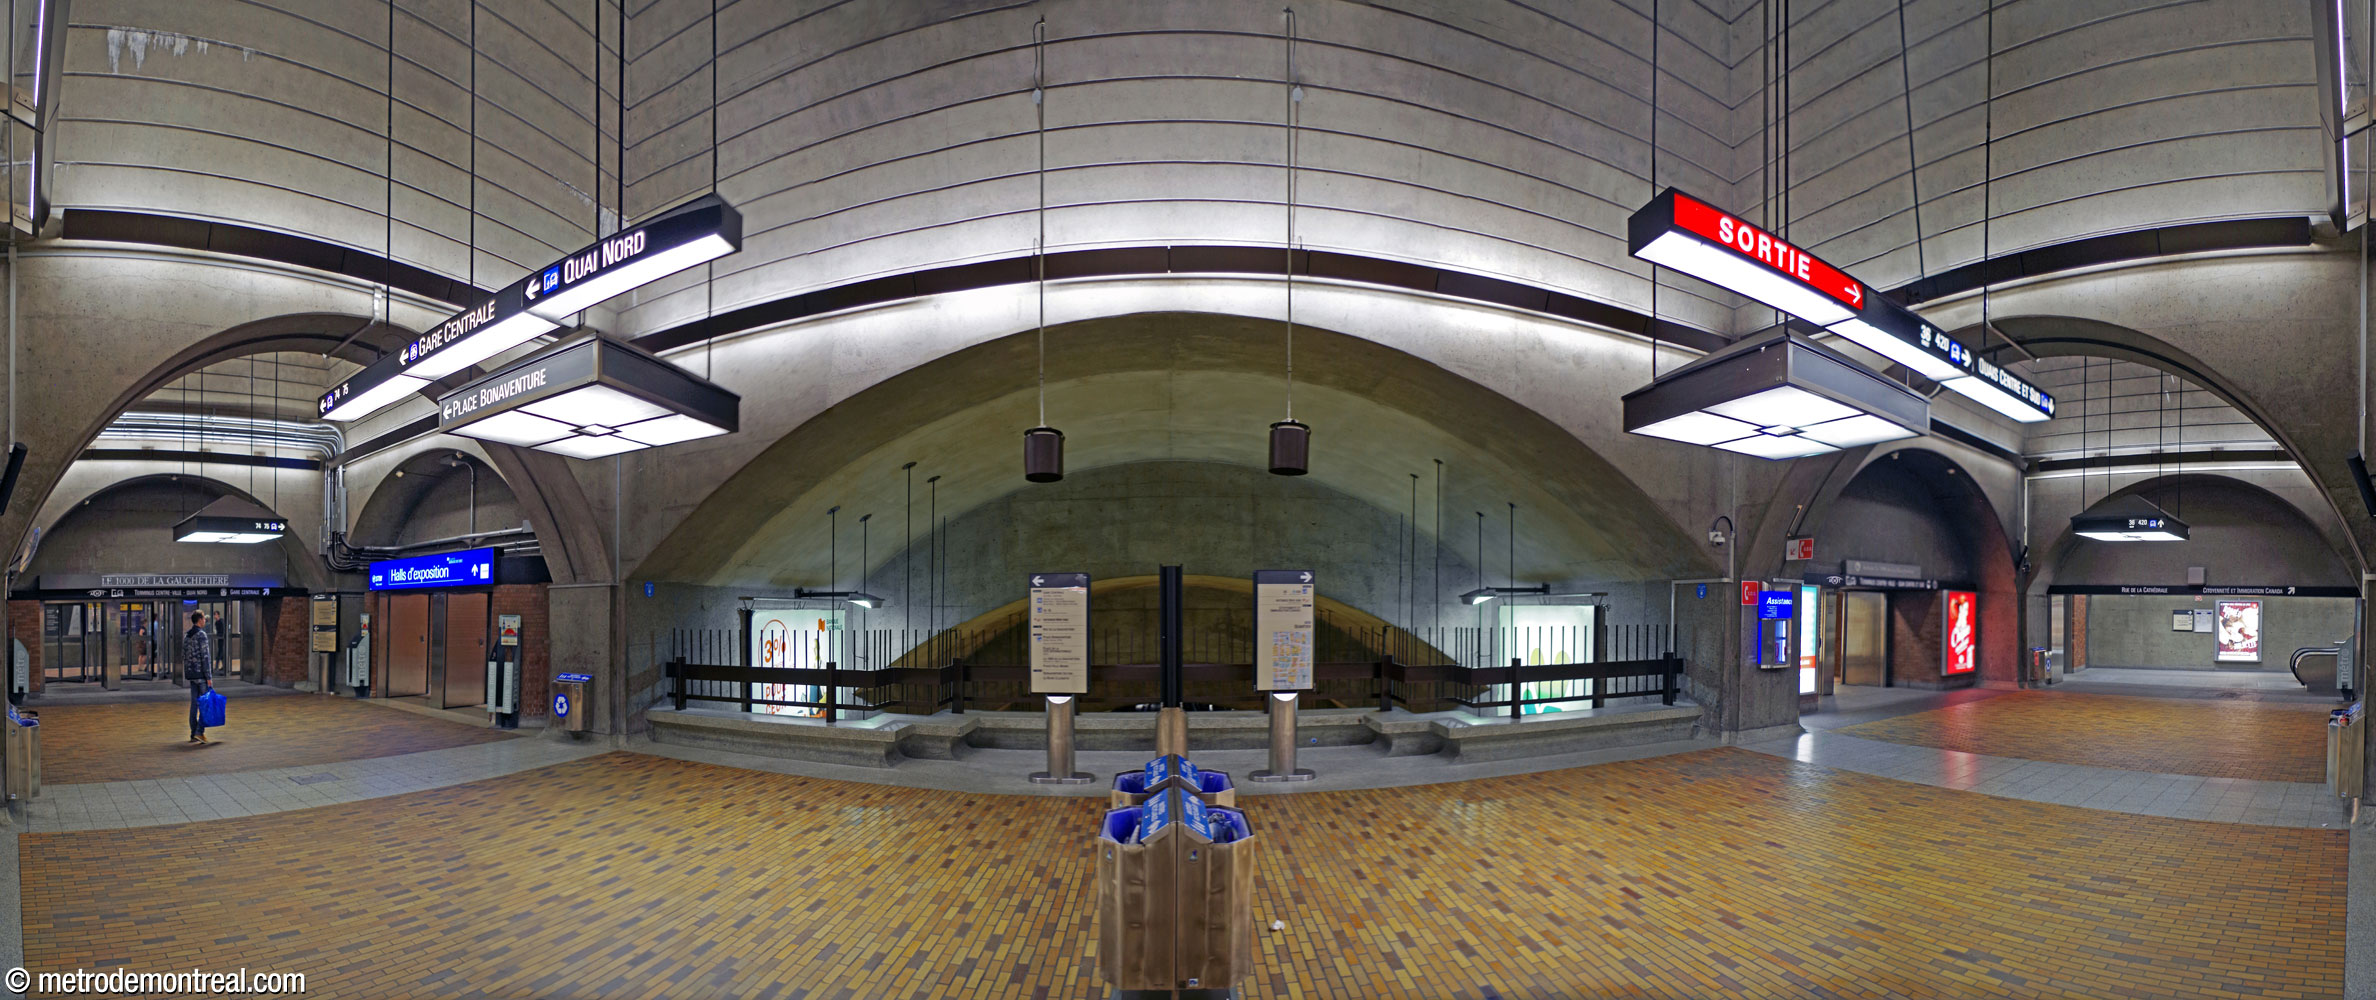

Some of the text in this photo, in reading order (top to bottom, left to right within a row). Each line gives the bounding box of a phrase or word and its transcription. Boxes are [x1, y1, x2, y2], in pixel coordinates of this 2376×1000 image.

[564, 230, 646, 284] QUAI NORD
[1718, 216, 1810, 281] SORTIE
[418, 301, 496, 357] GARE CENTRALE
[1920, 324, 1932, 342] 36
[1935, 332, 1950, 352] 420
[334, 382, 349, 400] 74 75
[452, 368, 546, 418] PLACE BONAVENTURE
[1999, 368, 2022, 396] CENTRE
[101, 576, 112, 586] LE
[116, 576, 134, 586] 1000
[137, 576, 150, 586] DE
[153, 576, 165, 586] LA
[390, 564, 449, 583] Halls d'exposition
[17, 650, 26, 684] métro
[2340, 648, 2350, 681] métro
